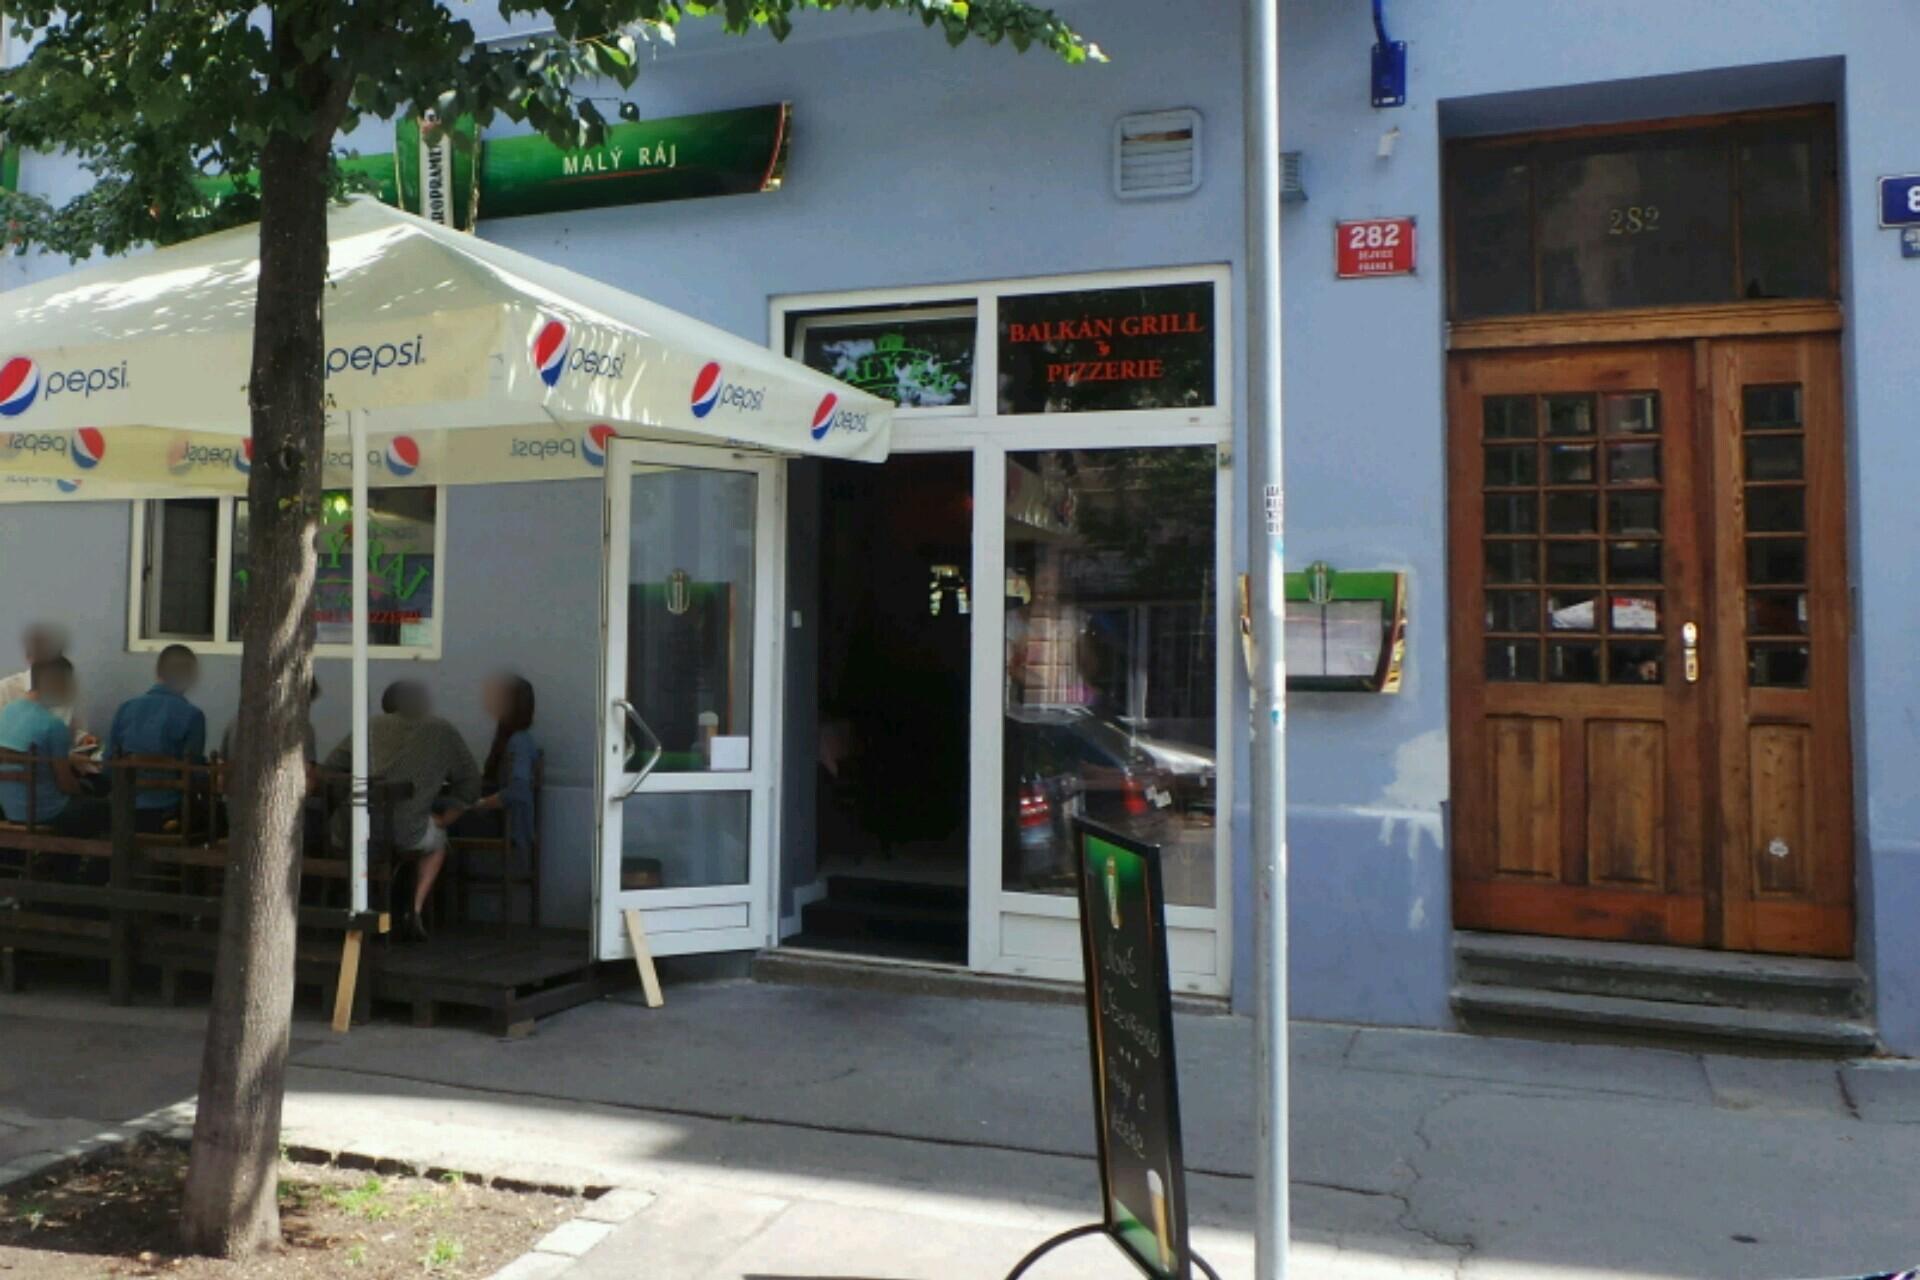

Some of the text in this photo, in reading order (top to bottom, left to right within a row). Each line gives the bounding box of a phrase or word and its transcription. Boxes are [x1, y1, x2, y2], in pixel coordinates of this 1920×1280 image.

[563, 139, 677, 175] MALÝ RÁJ
[1608, 206, 1660, 235] 282
[1349, 223, 1400, 250] 282
[1008, 312, 1206, 343] BALKÁN GRILL
[325, 335, 423, 379] pepsi
[568, 347, 626, 380] pepsi
[1047, 359, 1164, 382] PIZZERIE
[45, 360, 127, 400] pepsi
[719, 384, 766, 413] pepsi
[832, 410, 869, 434] pepsi
